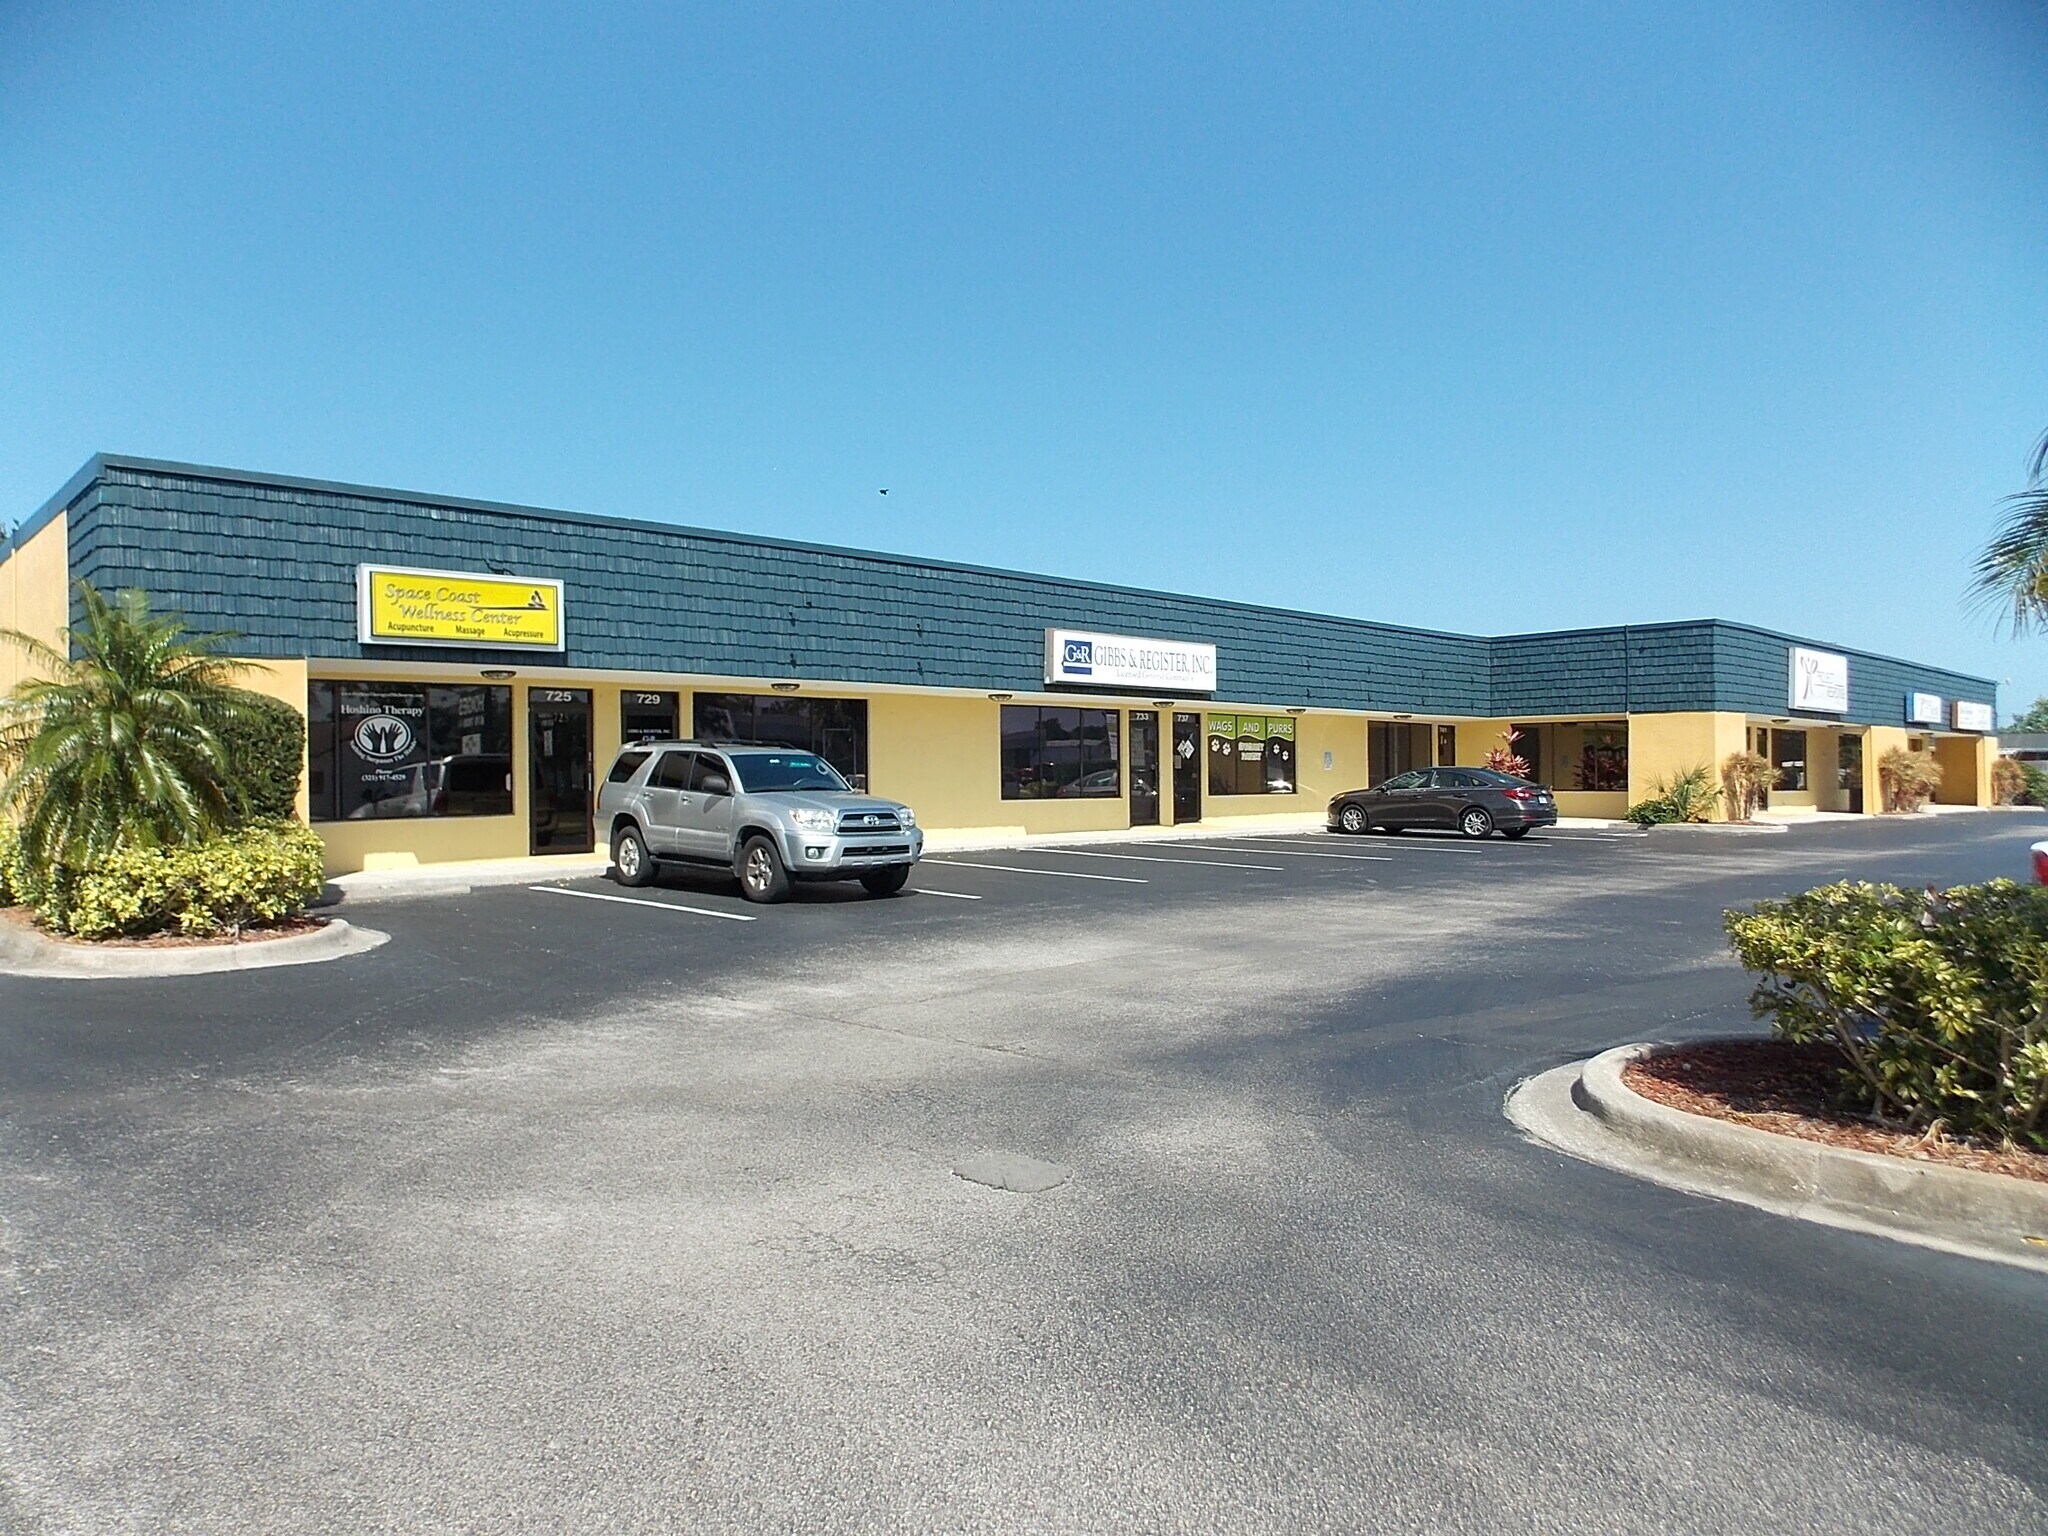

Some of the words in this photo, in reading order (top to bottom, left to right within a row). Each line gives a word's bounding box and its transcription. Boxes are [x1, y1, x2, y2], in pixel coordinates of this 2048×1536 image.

[385, 583, 431, 605] Space
[436, 587, 481, 604] Coast
[399, 603, 466, 622] Wellness
[470, 608, 522, 625] Center
[387, 621, 434, 633] Acupuncture
[455, 625, 485, 636] Massage
[503, 628, 544, 639] Acupressure
[1094, 645, 1127, 668] GIBBS
[1128, 649, 1137, 668] &
[1140, 649, 1190, 674] REGISTER,
[1192, 654, 1213, 675] INC.
[545, 691, 572, 702] 725
[636, 693, 661, 705] 729
[341, 704, 382, 715] Hoshino
[383, 705, 426, 717] Therapy
[1136, 713, 1149, 721] 733
[1177, 714, 1189, 722] 737
[1208, 721, 1233, 732] WAGS
[1243, 722, 1260, 733] AND
[1268, 723, 1293, 734] PURRS
